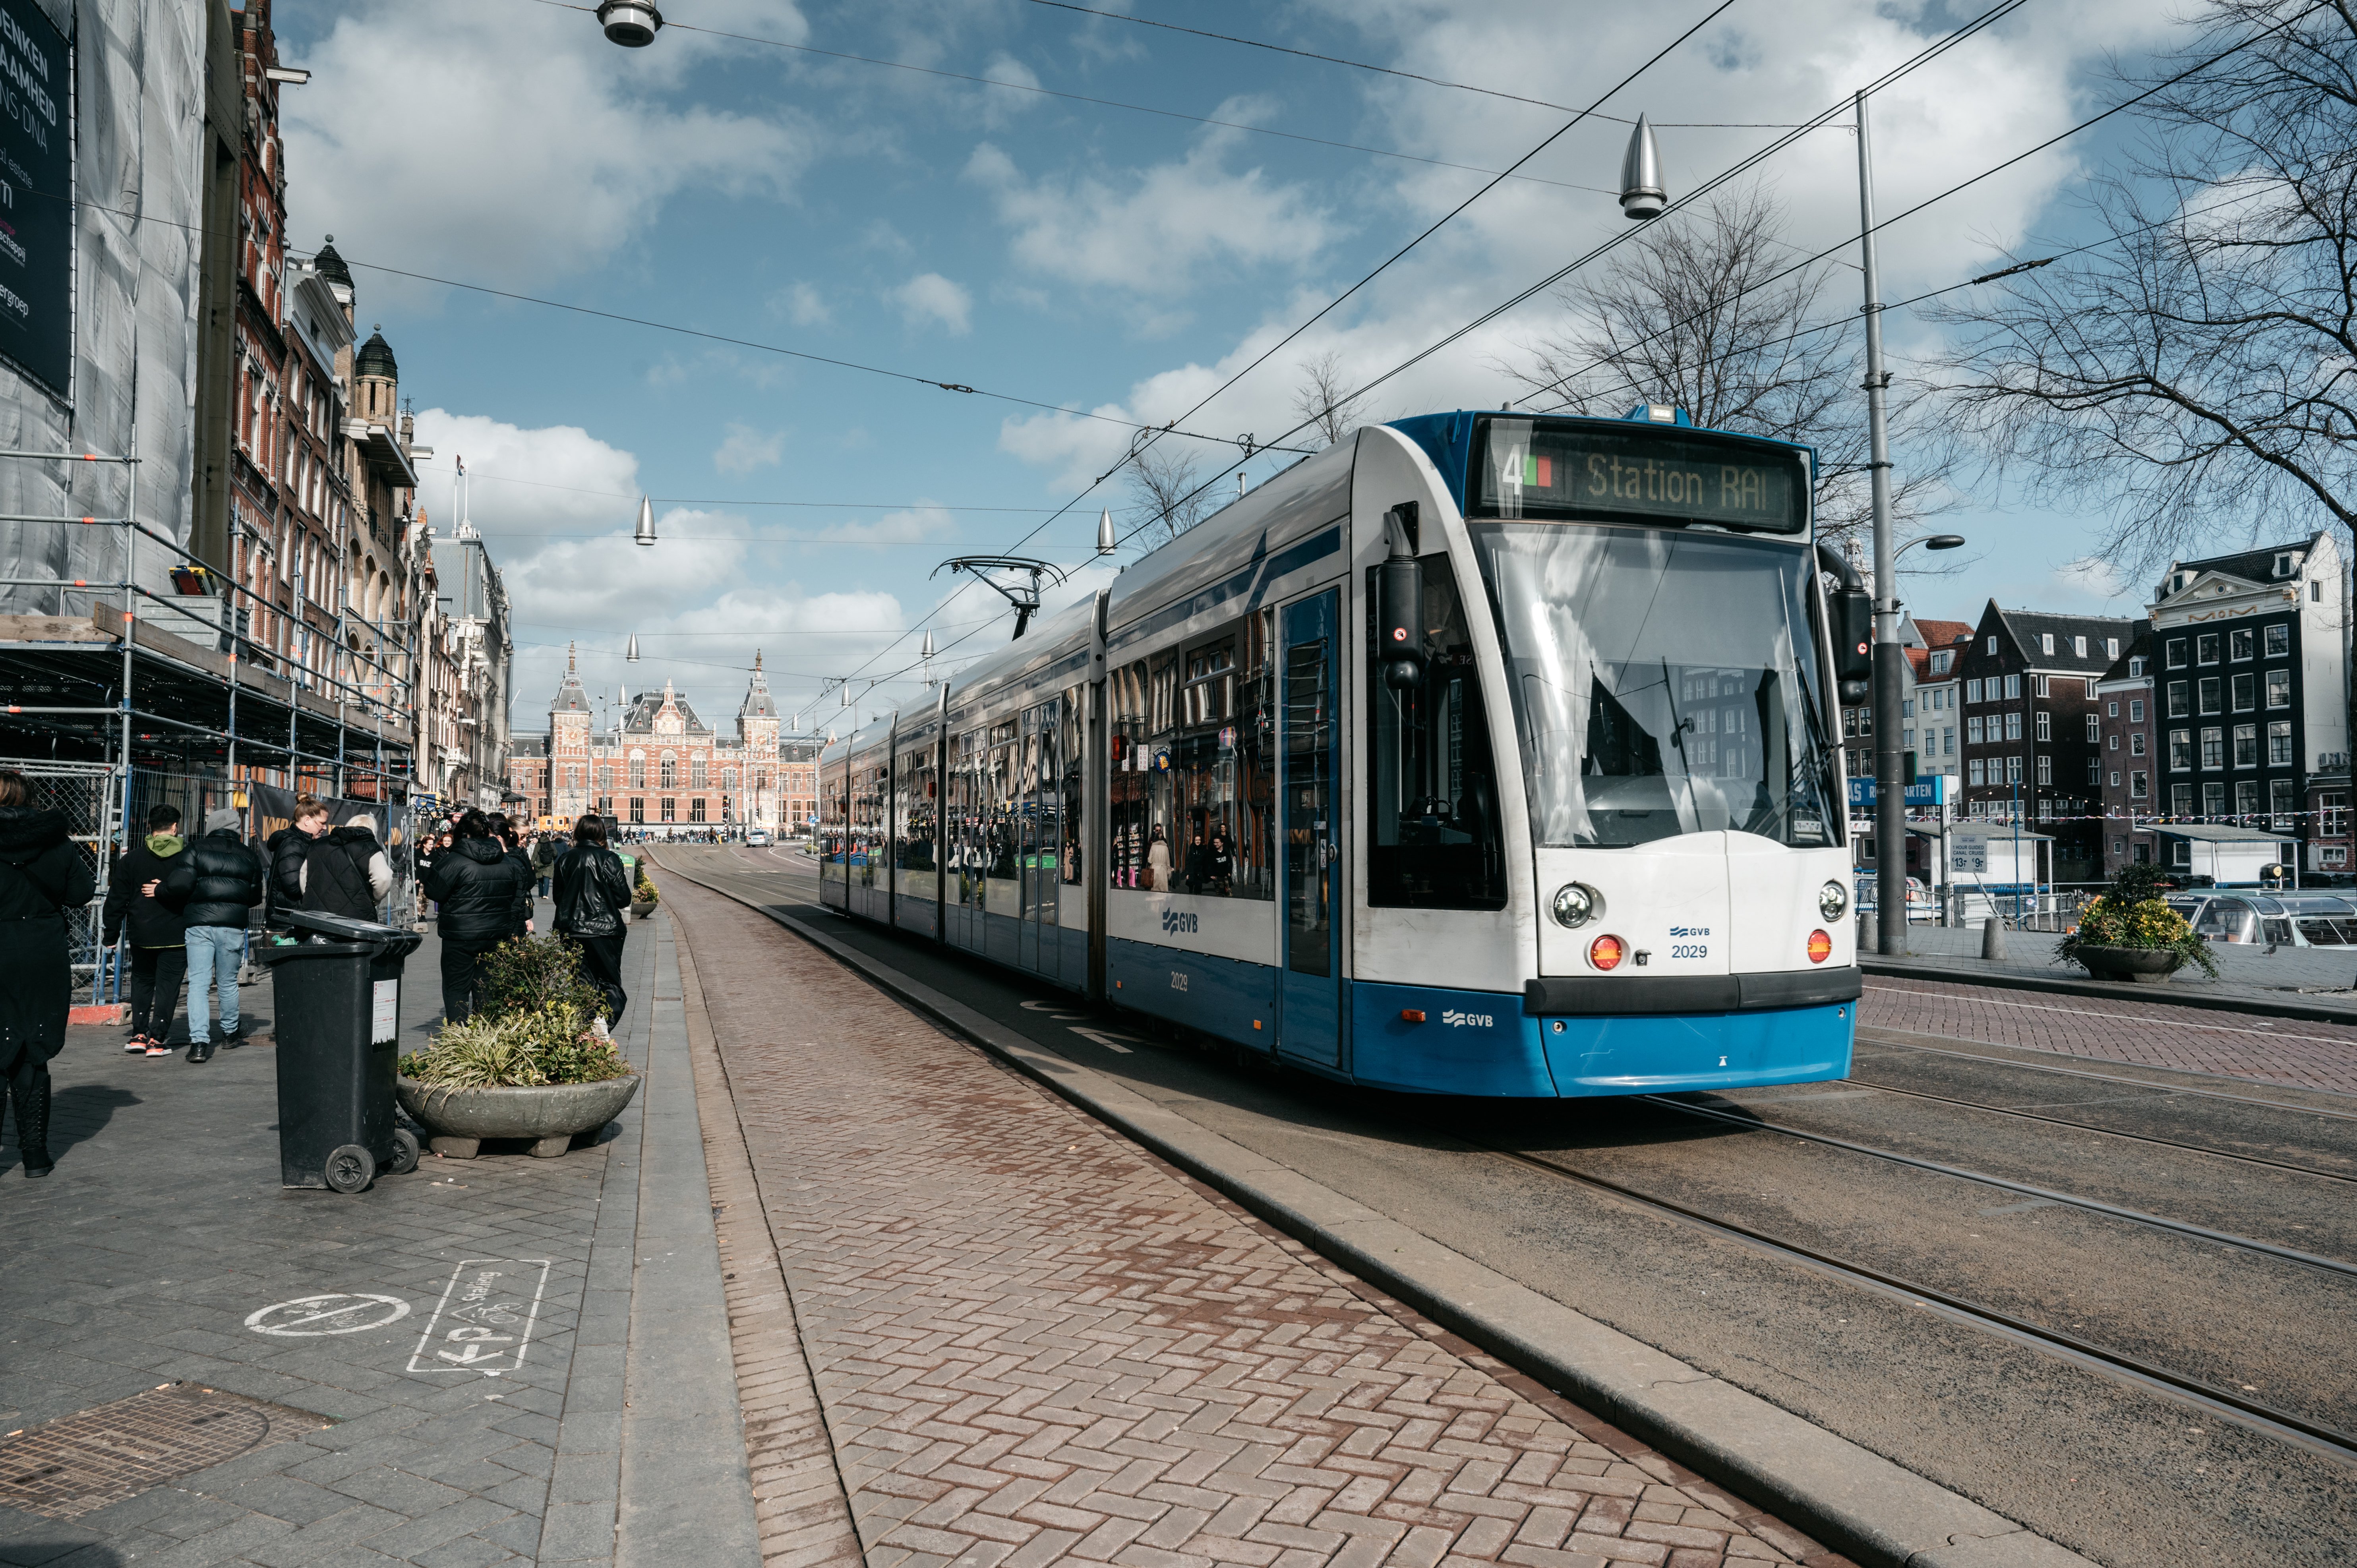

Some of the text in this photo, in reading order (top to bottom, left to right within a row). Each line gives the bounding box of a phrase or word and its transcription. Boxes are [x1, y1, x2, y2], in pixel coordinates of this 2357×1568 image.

[0, 7, 48, 83] ENKEN
[23, 104, 48, 155] DNA
[9, 159, 33, 189] estate
[1503, 444, 1767, 511] 4 Station RAI
[1178, 912, 1198, 934] GVB
[1690, 928, 1710, 937] GVB
[1672, 945, 1707, 959] 2029
[1171, 971, 1188, 992] 2029
[1466, 1013, 1493, 1028] GVB
[462, 1271, 502, 1302] Stalling
